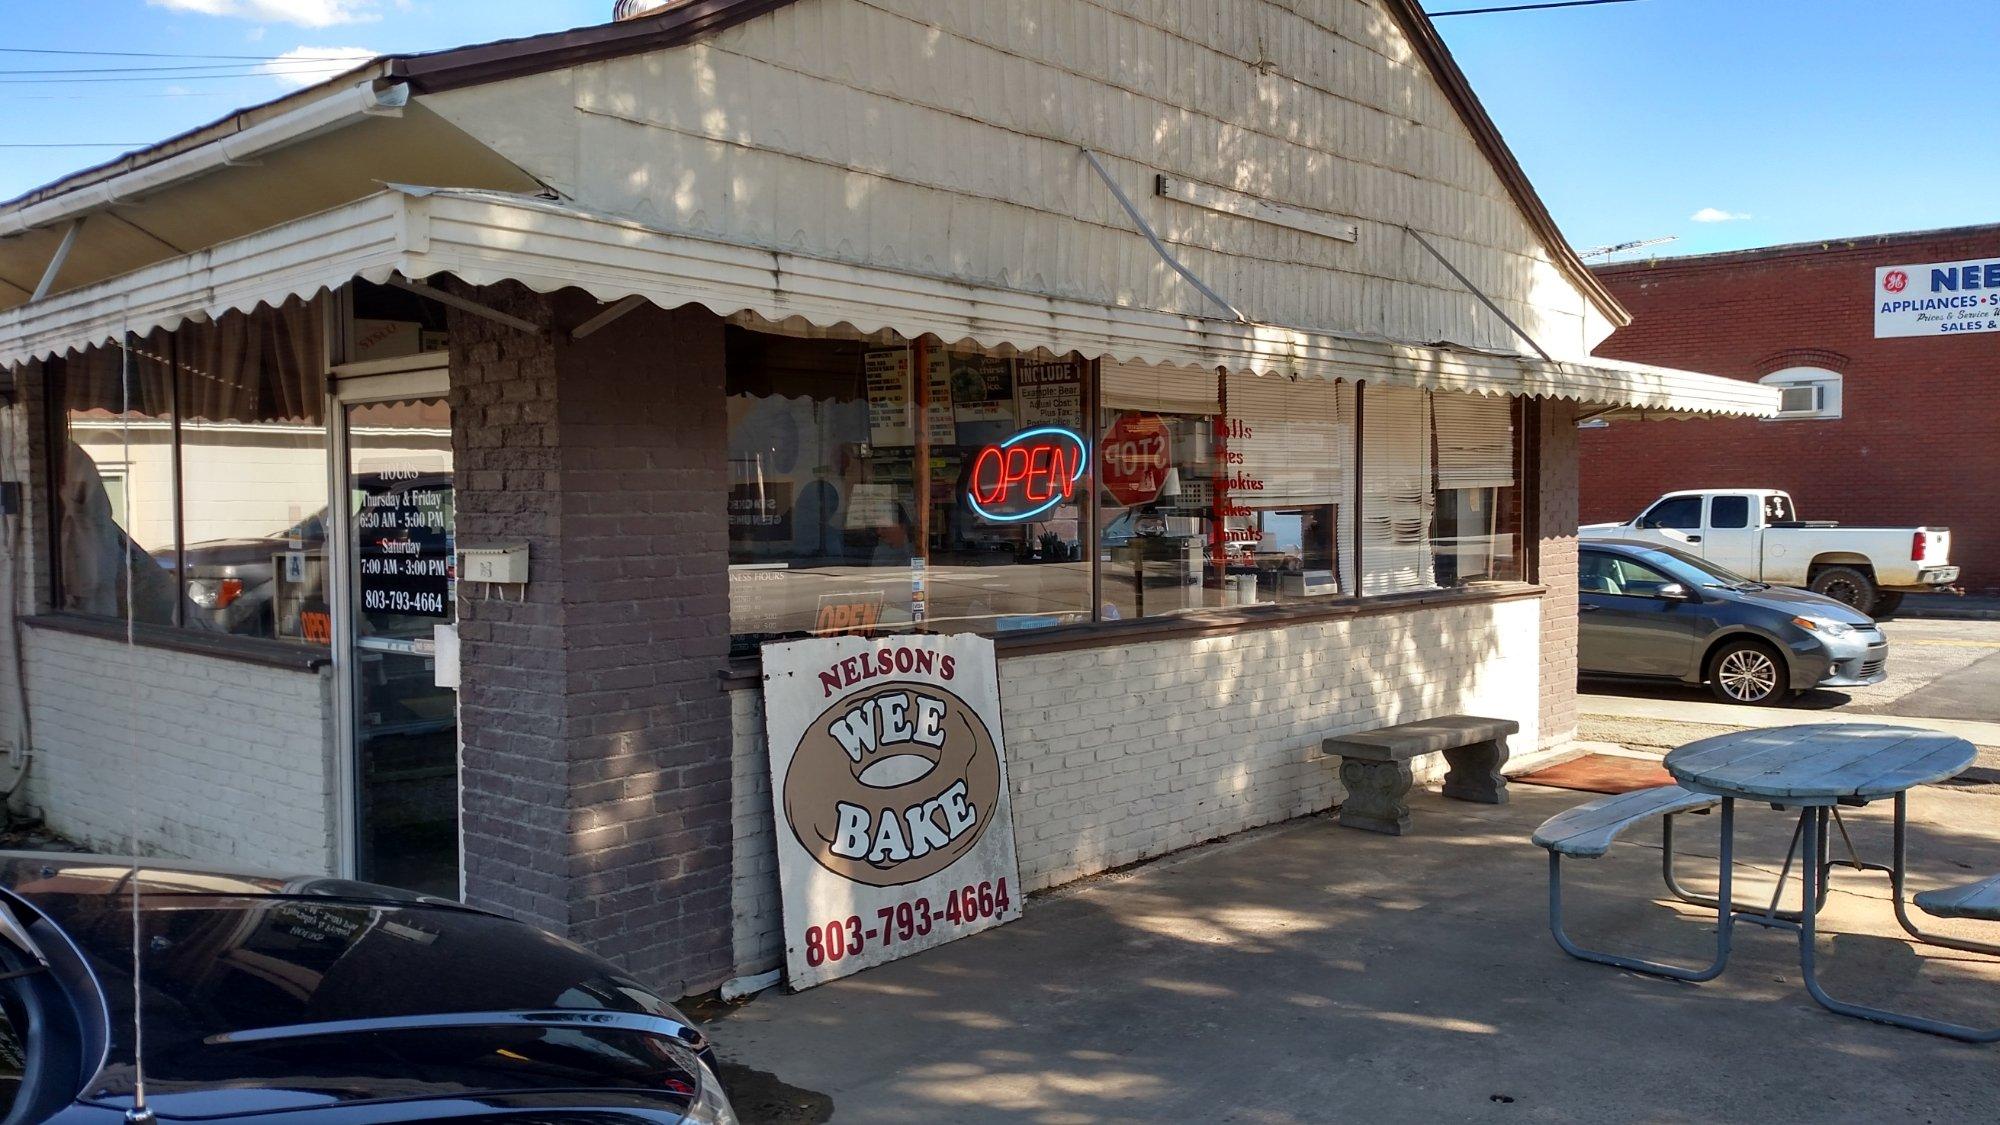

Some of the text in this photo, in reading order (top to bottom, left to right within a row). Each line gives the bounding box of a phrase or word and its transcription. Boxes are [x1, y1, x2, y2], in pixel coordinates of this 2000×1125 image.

[1881, 295, 1977, 313] APPLIANCES
[1917, 312, 1944, 322] Prices
[1958, 309, 1989, 320] Service
[1941, 320, 1997, 332] SALES &
[1020, 364, 1071, 383] INCLUDE
[380, 463, 419, 480] HOURS
[972, 446, 1078, 503] OPEN
[362, 489, 442, 510] Thursday & Friday
[360, 512, 380, 528] 6:30
[381, 512, 397, 528] AM
[404, 511, 426, 528] 5:00
[428, 511, 444, 527] PM
[381, 537, 421, 559] Saturday
[361, 558, 381, 574] 7:00
[382, 558, 398, 575] AM
[405, 559, 427, 576] 3:00
[428, 560, 446, 576] PM
[754, 571, 785, 581] HOURS
[365, 589, 443, 613] 803-793-4664
[818, 602, 878, 637] OPEN
[818, 647, 956, 698] NELSON'S
[829, 692, 946, 763] WEE
[830, 780, 977, 863] BAKE
[804, 876, 1010, 968] 803-793-4664
